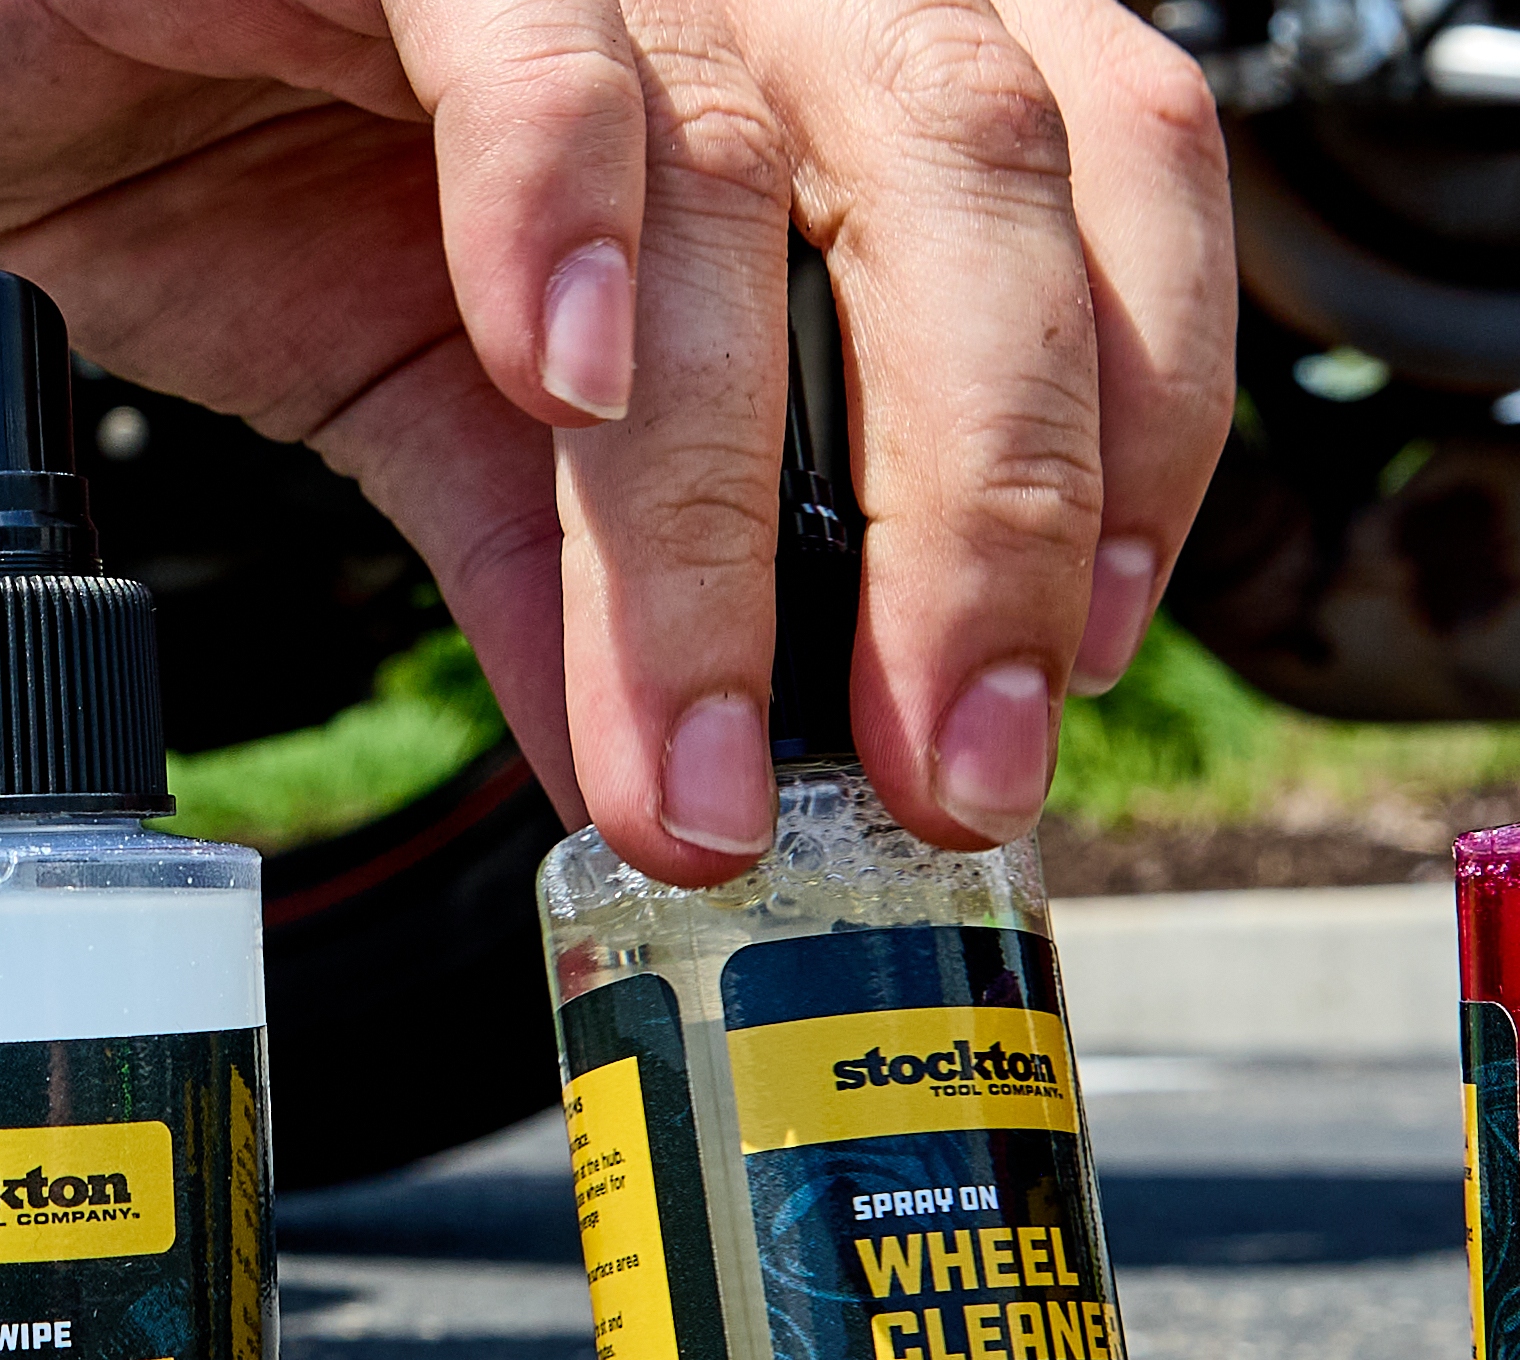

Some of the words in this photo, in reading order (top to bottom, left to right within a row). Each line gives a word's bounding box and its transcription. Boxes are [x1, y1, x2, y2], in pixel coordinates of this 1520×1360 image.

[833, 1040, 1057, 1091] stockton
[930, 1084, 982, 1098] TOOL
[601, 1148, 626, 1170] hub.
[610, 1175, 626, 1192] for
[852, 1187, 954, 1220] SPRAY
[960, 1185, 998, 1211] ON
[616, 1253, 639, 1272] area
[855, 1226, 1079, 1299] WHEEL
[608, 1310, 623, 1332] and
